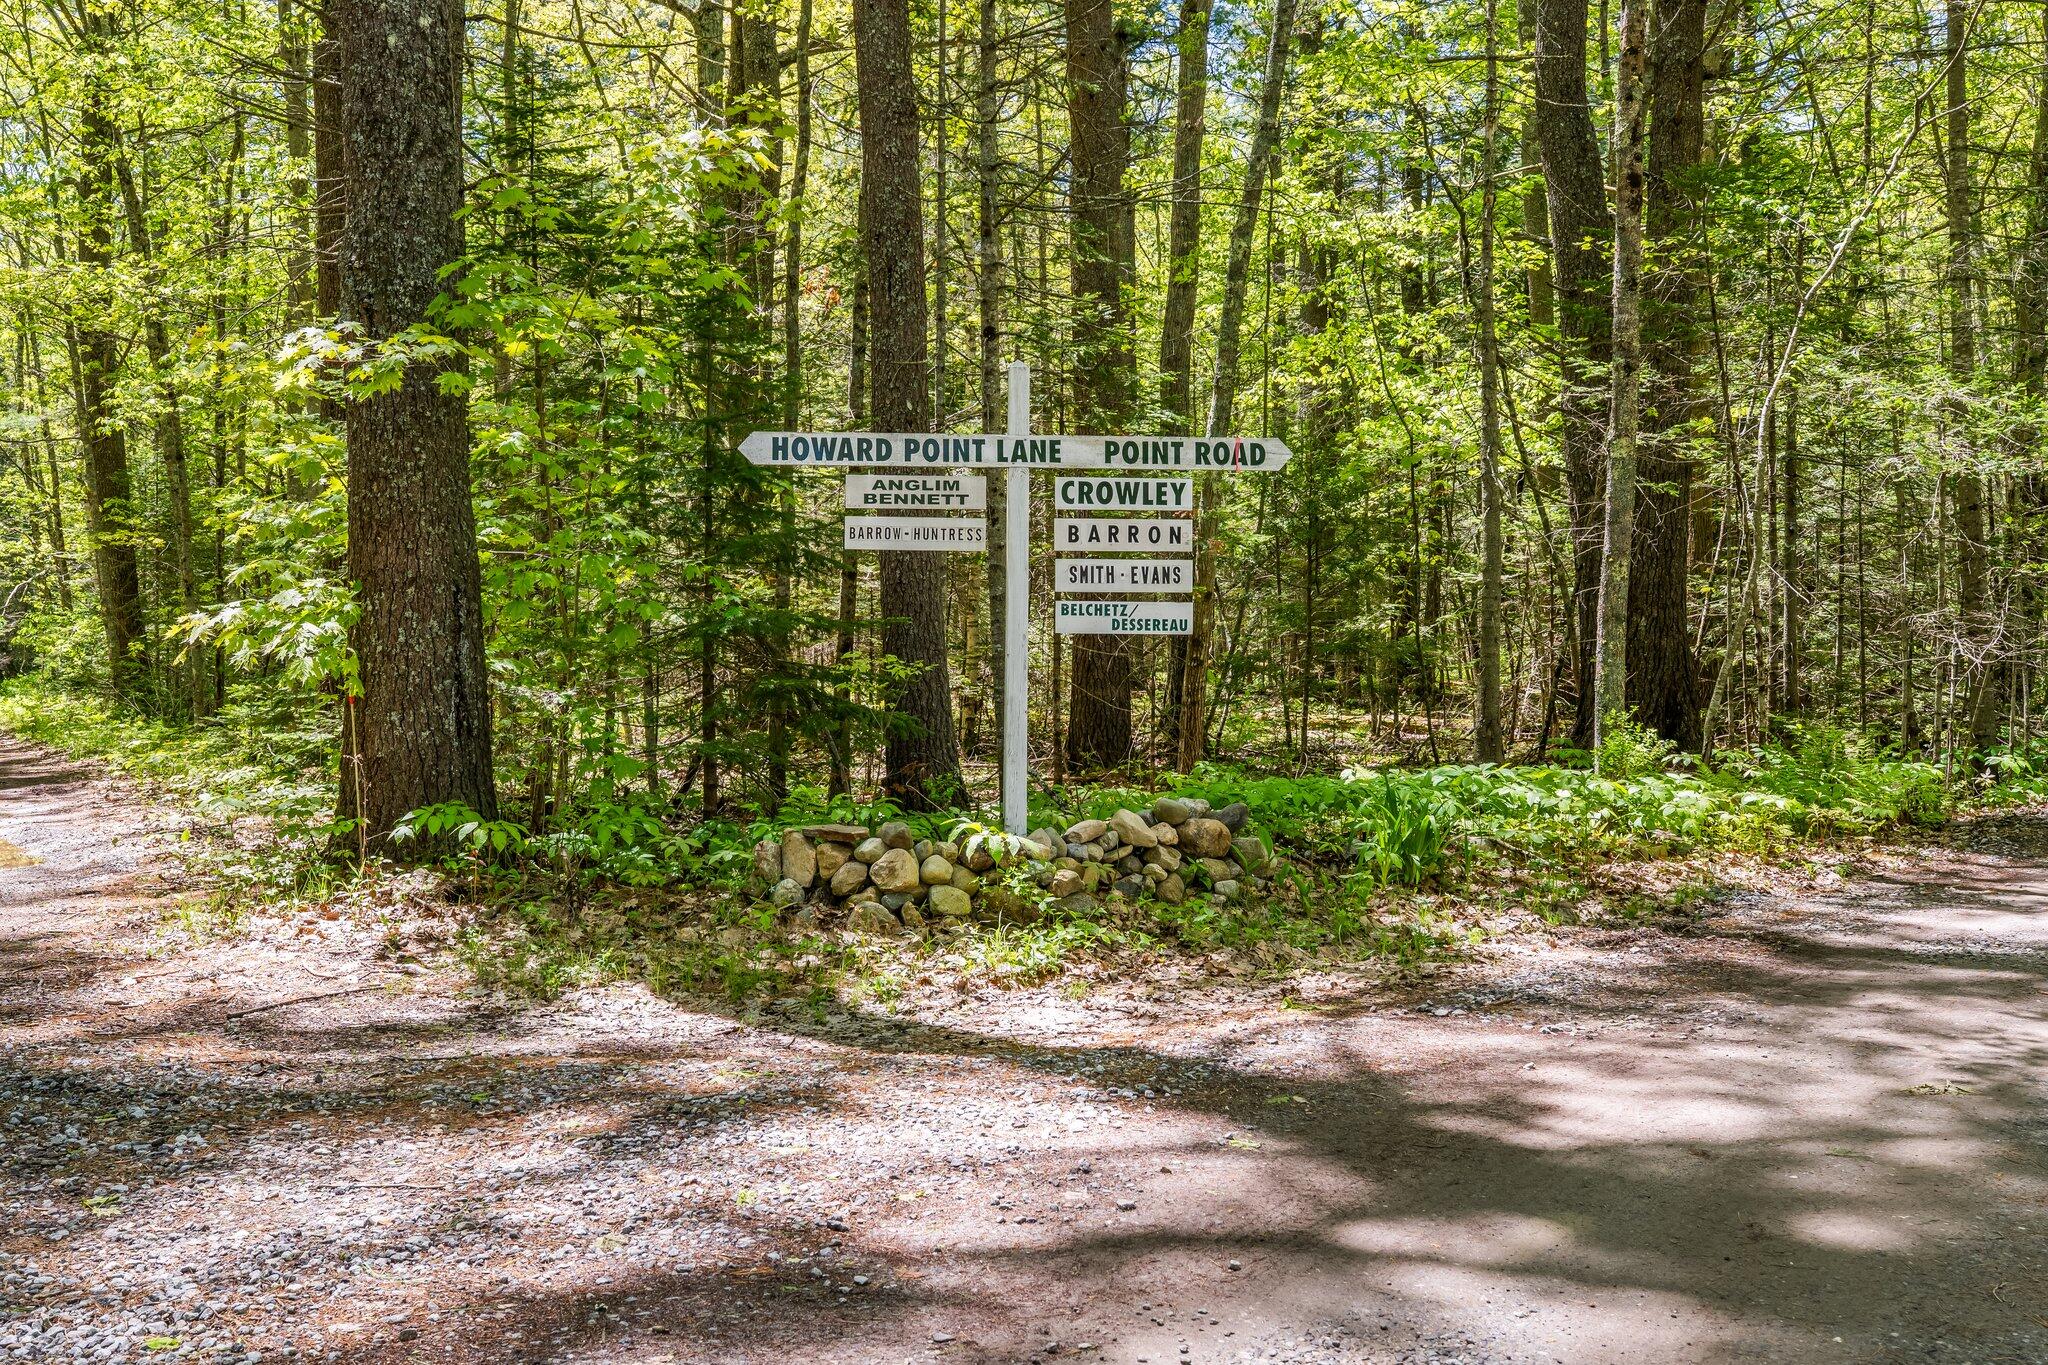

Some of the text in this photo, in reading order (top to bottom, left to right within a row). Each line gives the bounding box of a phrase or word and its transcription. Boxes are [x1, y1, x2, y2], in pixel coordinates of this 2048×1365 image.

[771, 436, 1062, 463] HOWARD POINT LANE
[1104, 440, 1266, 466] POINT ROAD
[871, 479, 960, 491] ANGLIM
[1060, 480, 1187, 506] CROWLEY
[863, 493, 970, 505] BENNETT
[1067, 524, 1182, 545] BARRON
[1069, 565, 1115, 584] SMITH
[1130, 566, 1182, 584] EVANS
[1111, 618, 1188, 632] DESSEREAU
